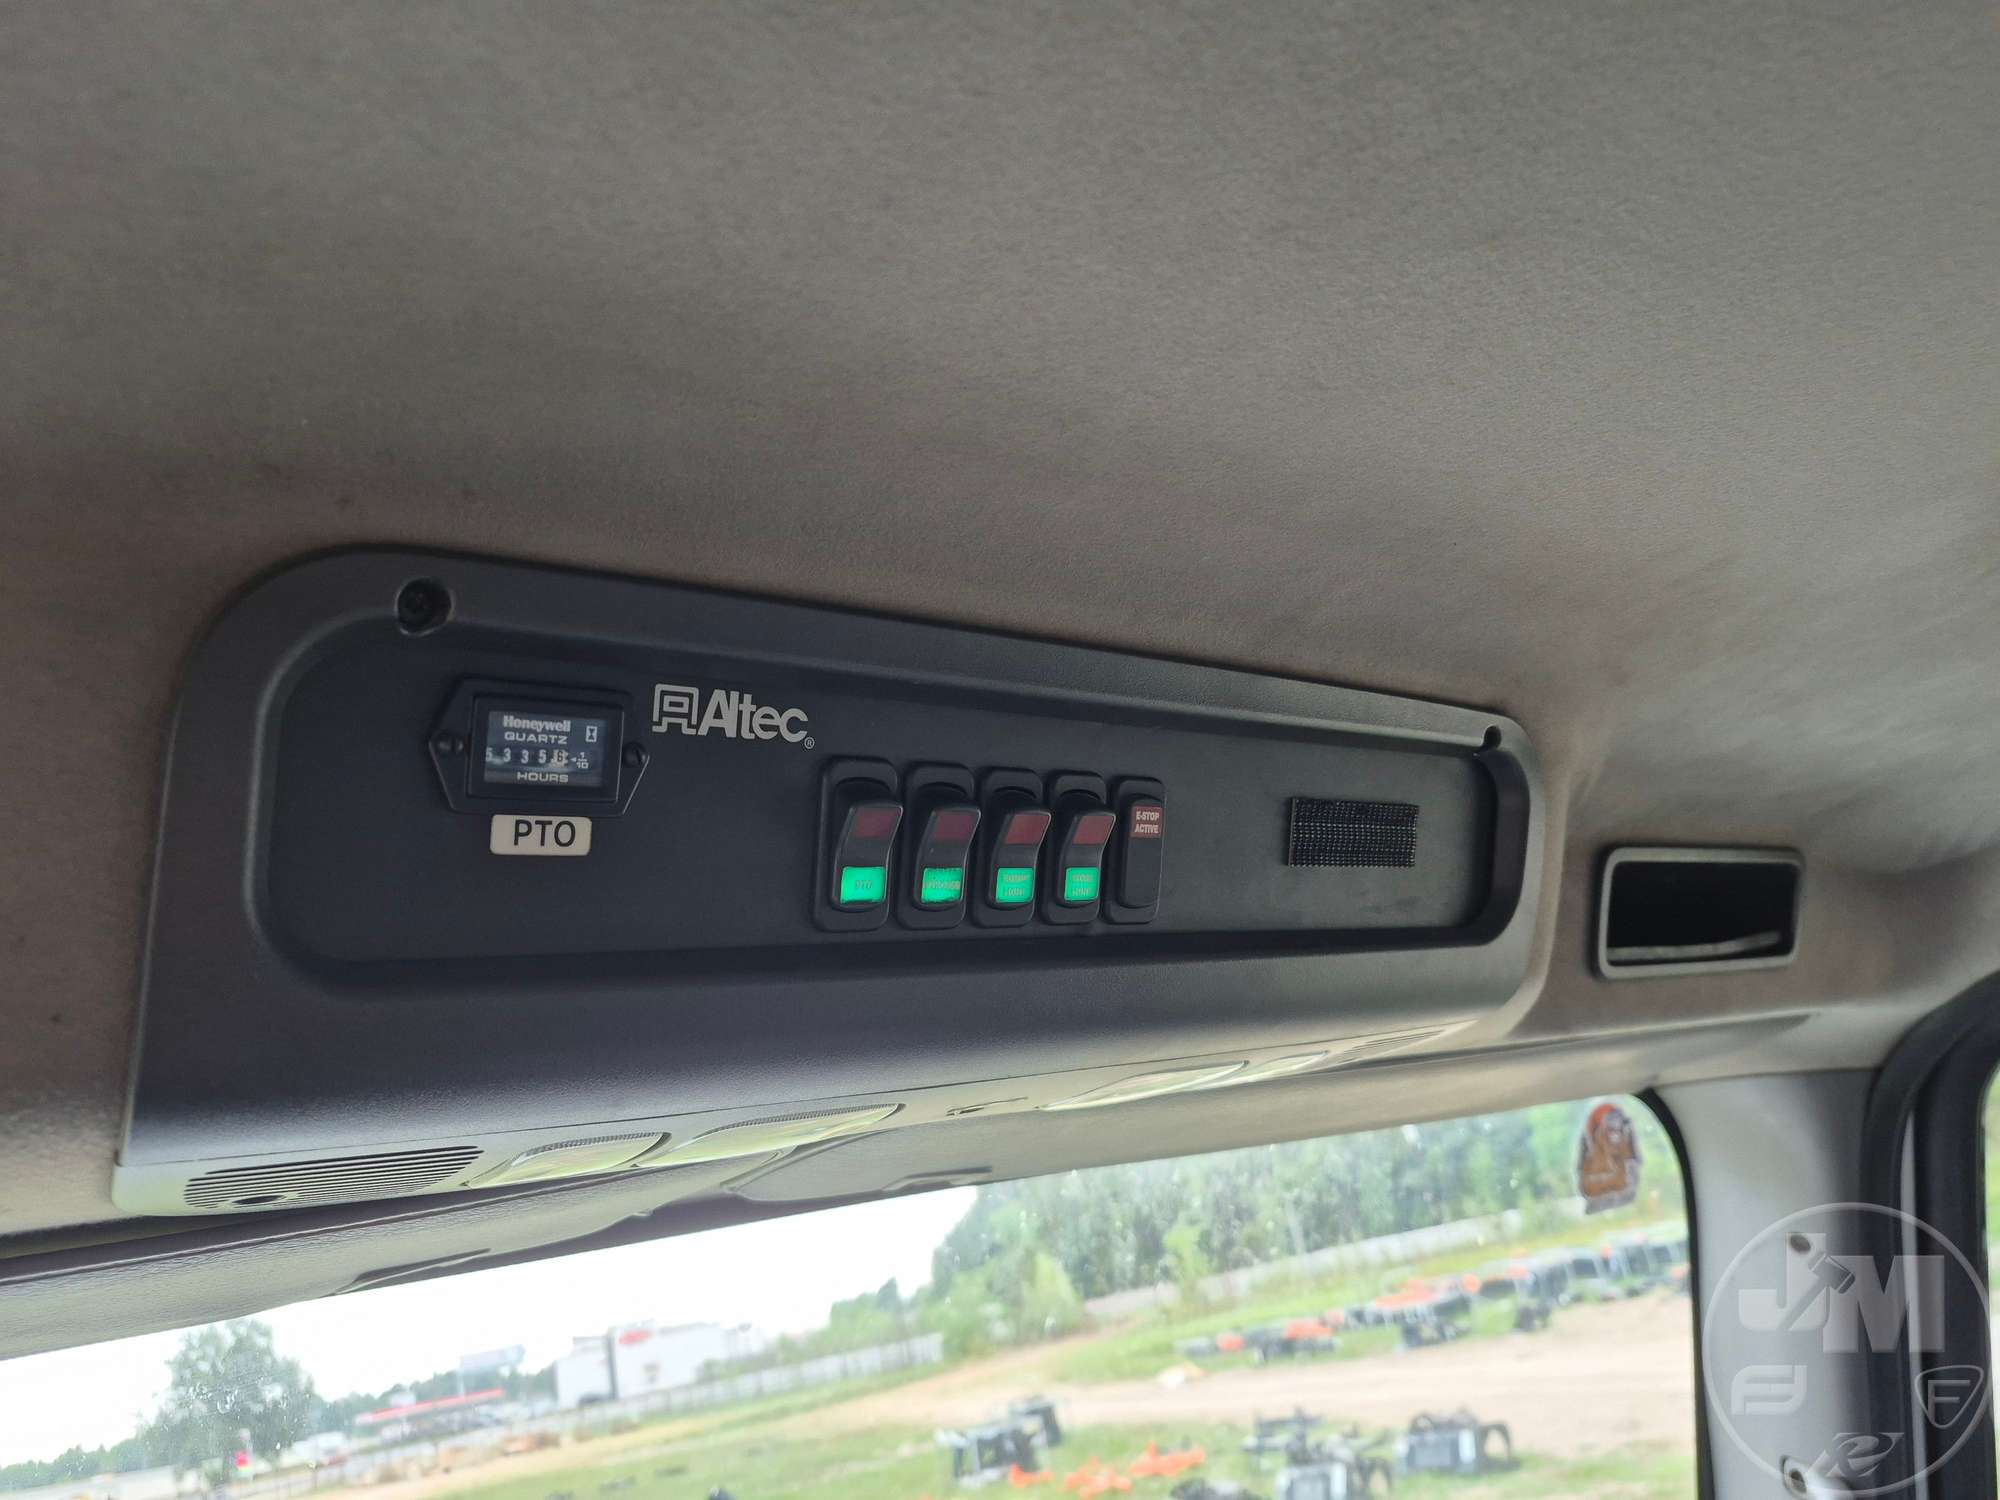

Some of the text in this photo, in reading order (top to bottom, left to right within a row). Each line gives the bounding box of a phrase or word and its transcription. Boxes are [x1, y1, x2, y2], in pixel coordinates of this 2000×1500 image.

[697, 688, 809, 743] Altec
[503, 715, 571, 732] Honeywell
[504, 731, 568, 745] QUARTZ
[516, 771, 568, 783] HOURS
[1135, 810, 1160, 821] E-STOP
[513, 819, 576, 848] PTO
[1134, 823, 1160, 834] ACTIVE
